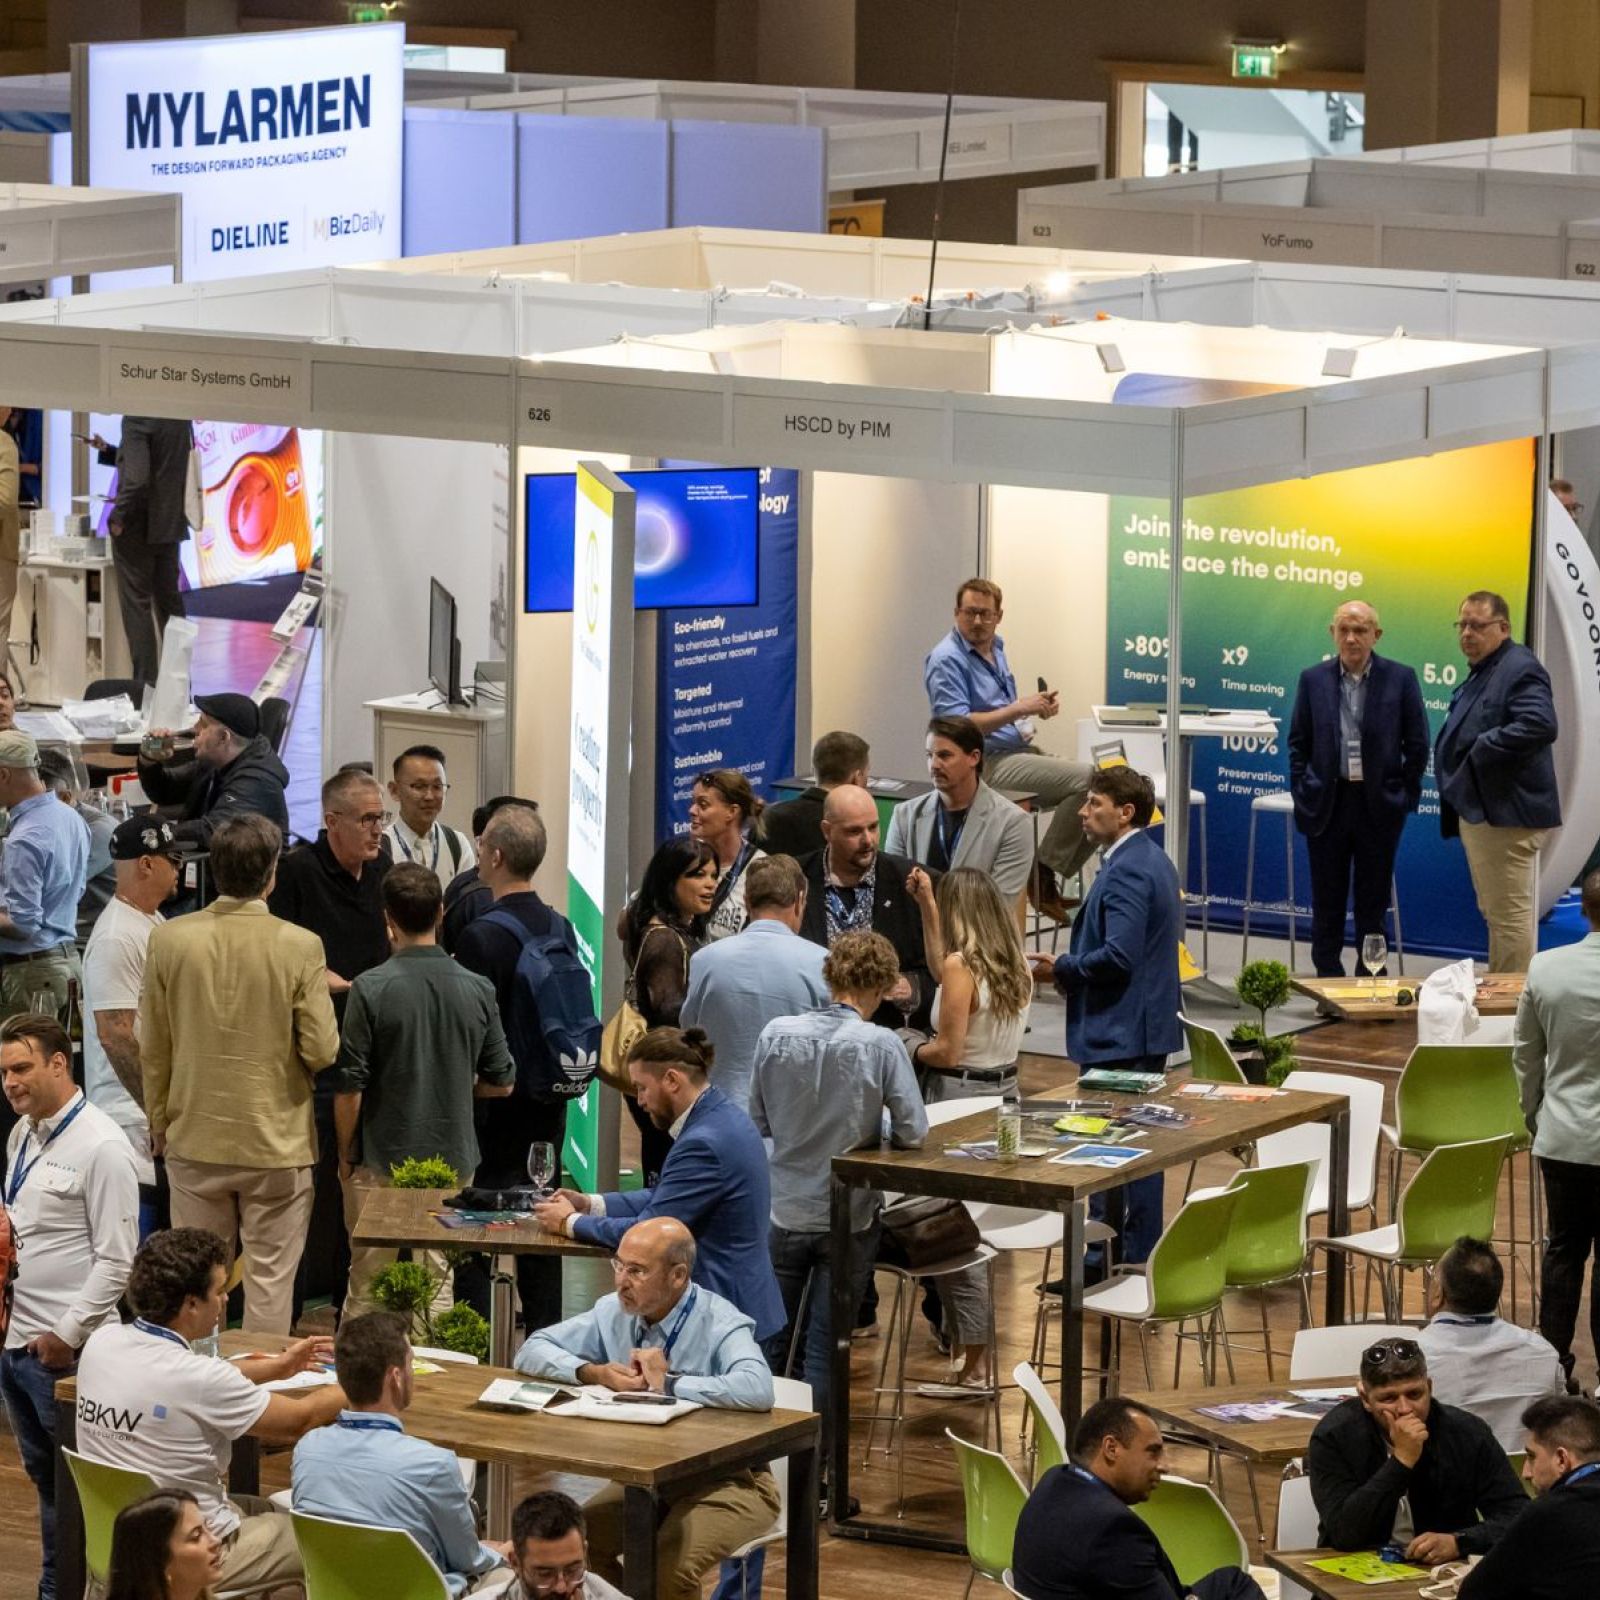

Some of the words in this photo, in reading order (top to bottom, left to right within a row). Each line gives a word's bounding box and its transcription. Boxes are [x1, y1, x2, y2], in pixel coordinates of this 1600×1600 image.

[126, 74, 371, 149] MYLARMEN
[151, 163, 171, 176] THE
[171, 161, 207, 175] DESIGN
[208, 157, 254, 172] FORWARD
[256, 152, 309, 168] PACKAGING
[312, 146, 347, 162] AGENCY
[314, 209, 385, 241] MJBizDaily
[1033, 225, 1051, 237] 623
[211, 221, 289, 252] DIELINE
[1262, 233, 1313, 249] YoFumo
[1575, 263, 1596, 276] 622
[120, 363, 157, 379] Schur
[161, 366, 187, 382] Star
[191, 368, 246, 387] Systems
[249, 372, 291, 389] GmbH
[528, 407, 551, 422] 626
[785, 414, 832, 433] HSCD
[837, 419, 855, 440] by
[860, 420, 891, 438] PIM
[759, 493, 790, 515] logy
[1124, 513, 1171, 538] Join
[1219, 526, 1342, 557] revolution,
[1123, 548, 1226, 576] embace
[1231, 555, 1270, 579] the
[1274, 561, 1363, 591] change
[674, 615, 726, 635] Eco-friendly
[674, 643, 684, 653] No
[722, 635, 731, 645] no
[731, 630, 748, 643] fossil
[764, 626, 779, 638] and
[674, 654, 707, 668] extracted
[708, 651, 727, 662] water
[728, 646, 758, 659] recovery
[1222, 645, 1249, 666] x9
[1123, 668, 1159, 684] Energy
[1423, 662, 1457, 685] 5.0
[674, 682, 712, 702] Targeted
[1221, 678, 1247, 692] Time
[1249, 682, 1285, 697] saving
[674, 706, 702, 719] Moisture
[703, 703, 716, 714] and
[717, 697, 744, 711] thermal
[674, 720, 707, 736] uniformity
[708, 714, 732, 729] control
[1221, 735, 1279, 755] 100%
[674, 749, 723, 769] Sustainable
[751, 760, 766, 772] cost
[1218, 766, 1285, 783] Preservation
[1218, 782, 1229, 793] of
[1230, 784, 1252, 795] raw
